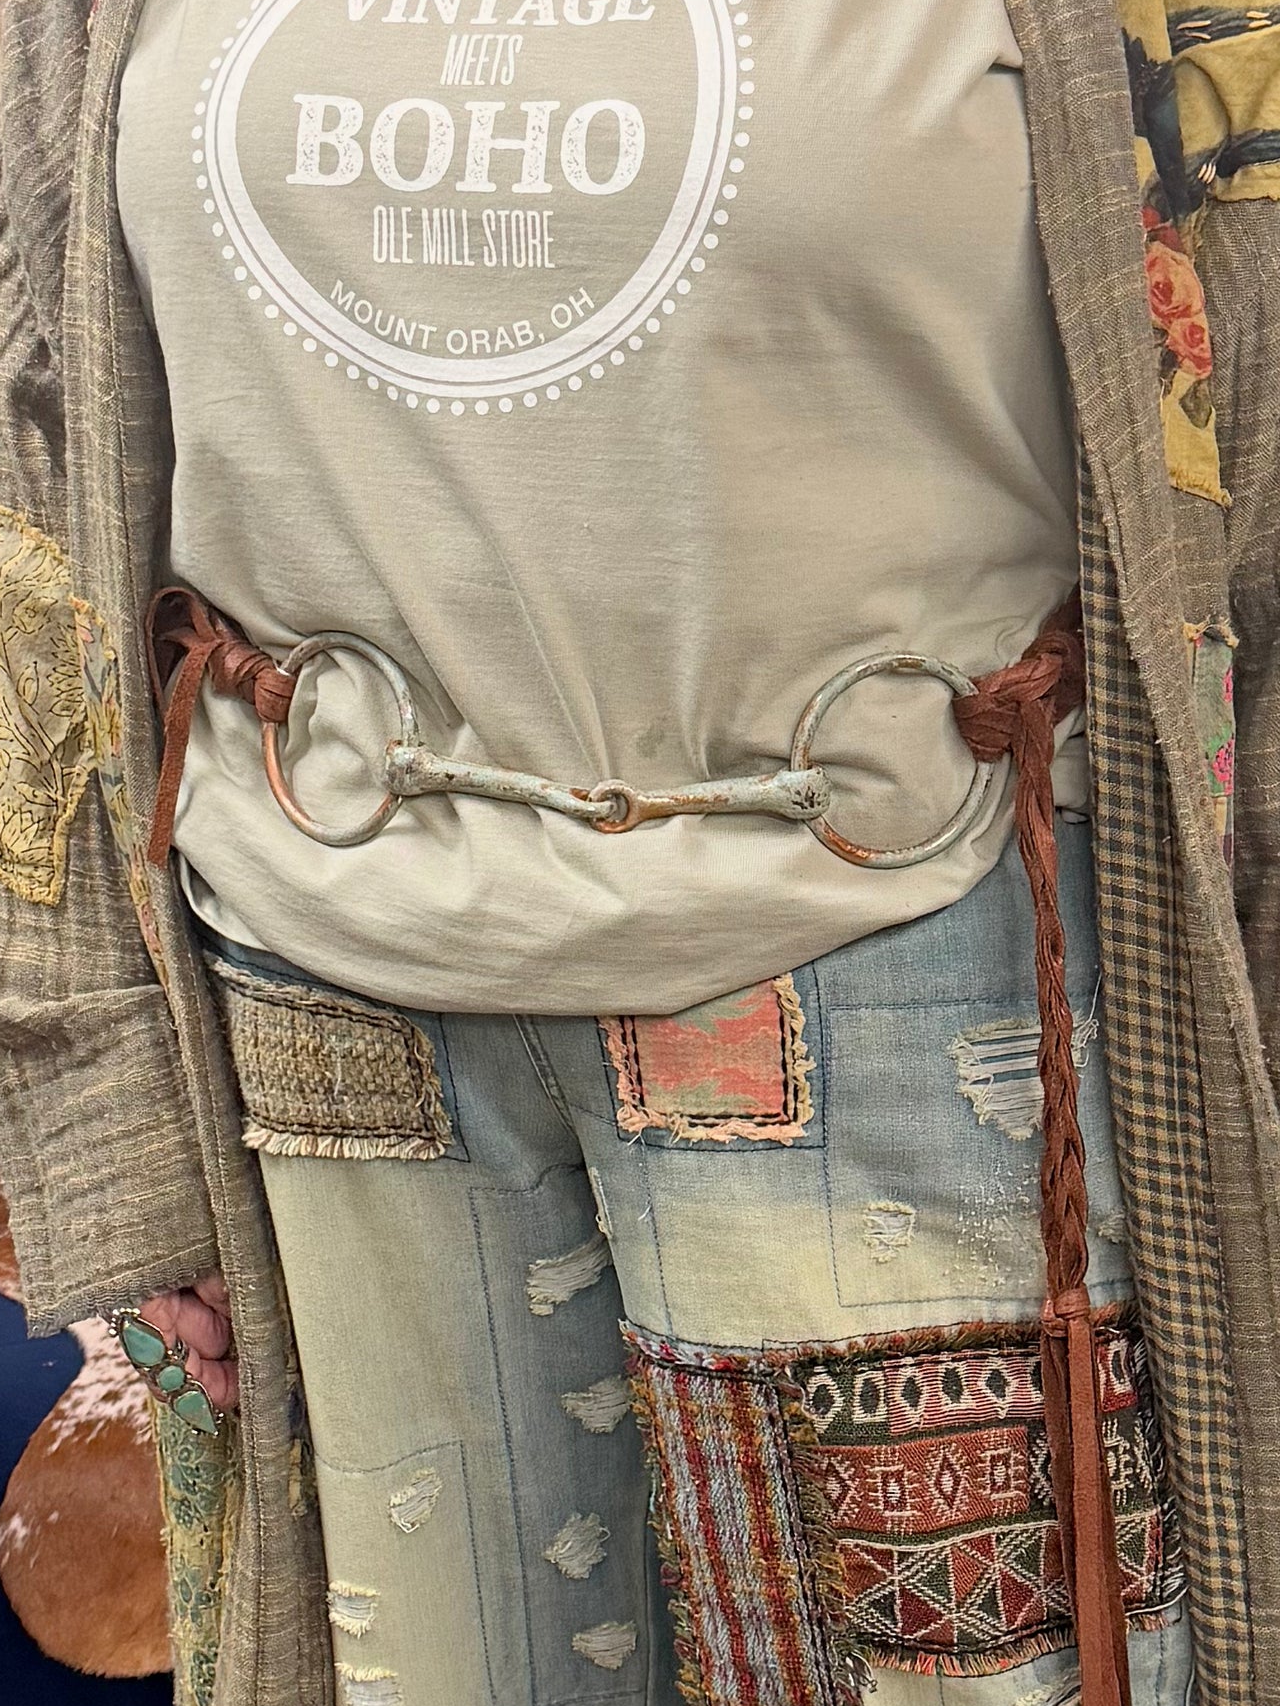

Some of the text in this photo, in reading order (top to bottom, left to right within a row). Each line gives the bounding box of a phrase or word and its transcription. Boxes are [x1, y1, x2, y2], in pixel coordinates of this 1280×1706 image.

[439, 33, 524, 86] MEETS
[285, 93, 646, 195] BOHO
[372, 204, 556, 269] OLE MILL STORE
[329, 279, 595, 355] MOUNT ORAB, OH
